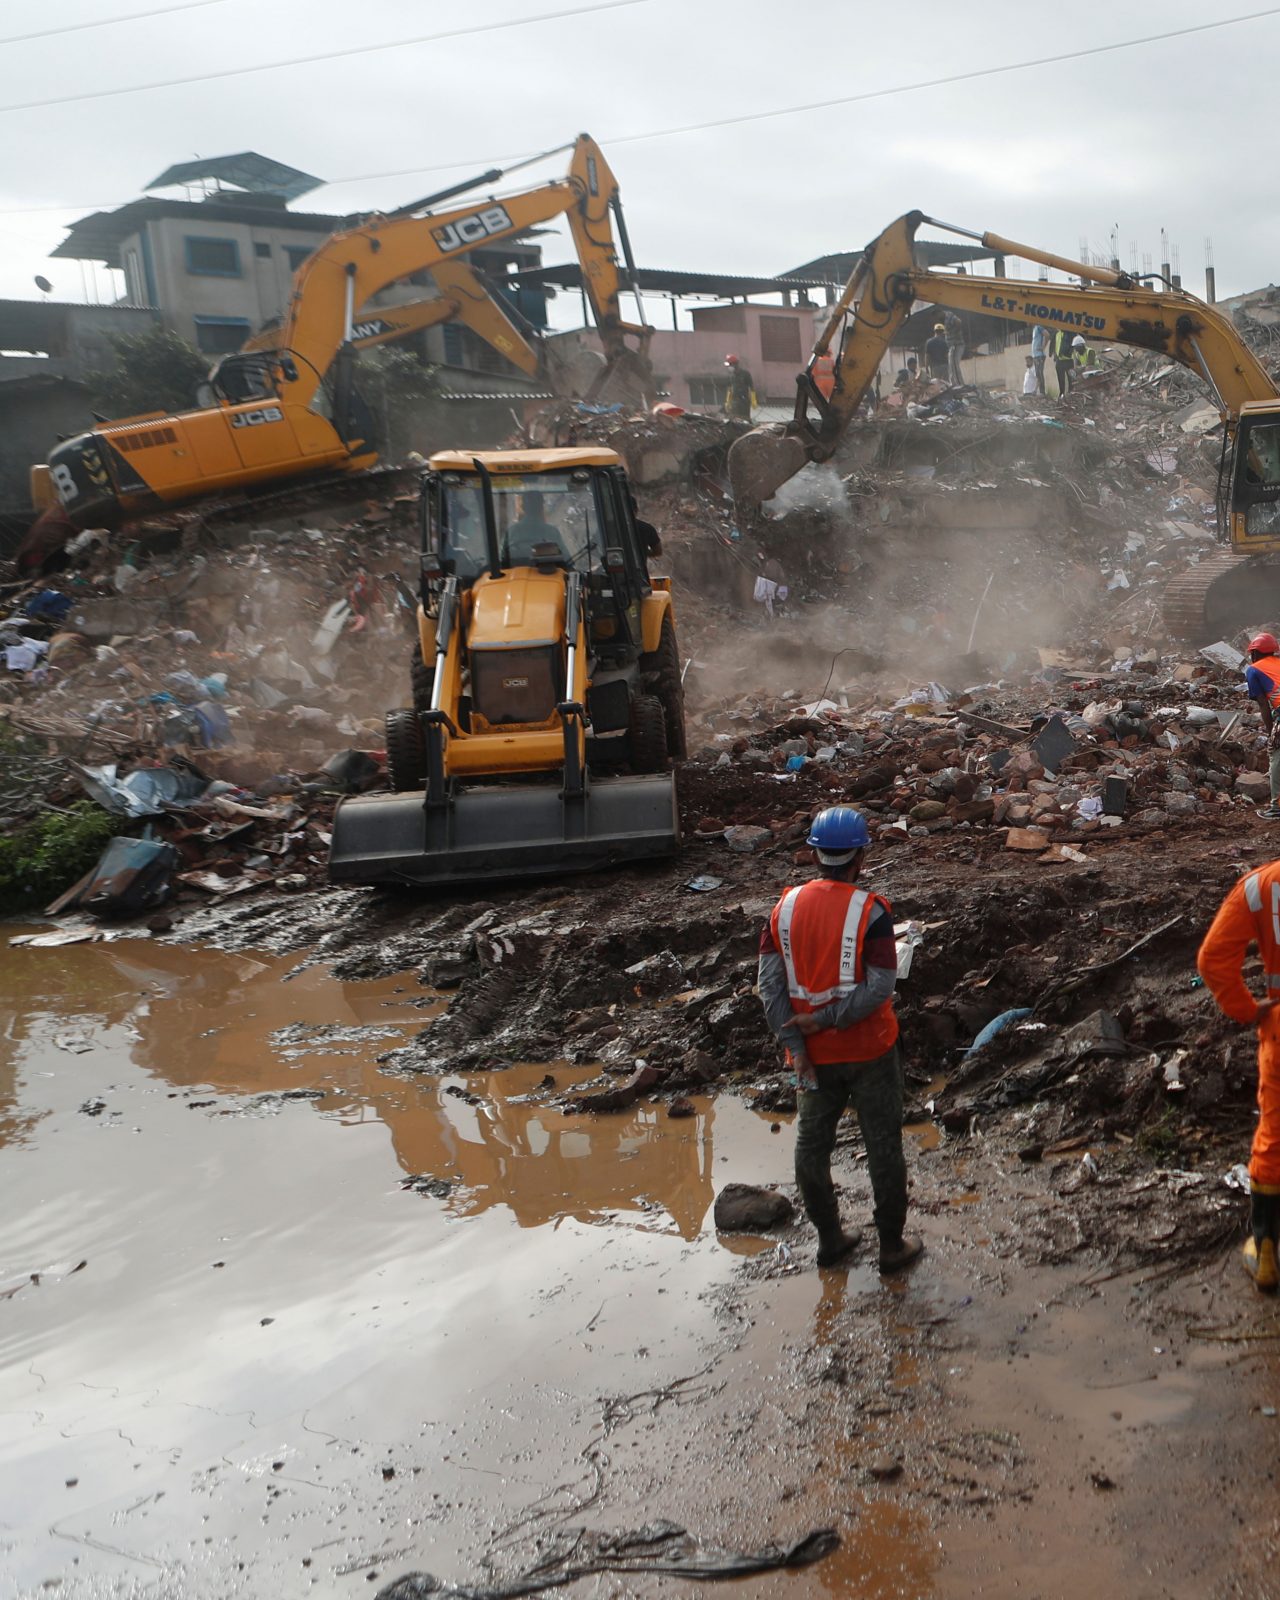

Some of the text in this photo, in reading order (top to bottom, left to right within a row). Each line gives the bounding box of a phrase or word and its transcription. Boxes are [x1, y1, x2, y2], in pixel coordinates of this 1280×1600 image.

[437, 205, 513, 252] JCB
[350, 320, 381, 339] ANY
[231, 407, 283, 429] JCB
[503, 678, 528, 688] JCB
[842, 937, 853, 968] FIRE
